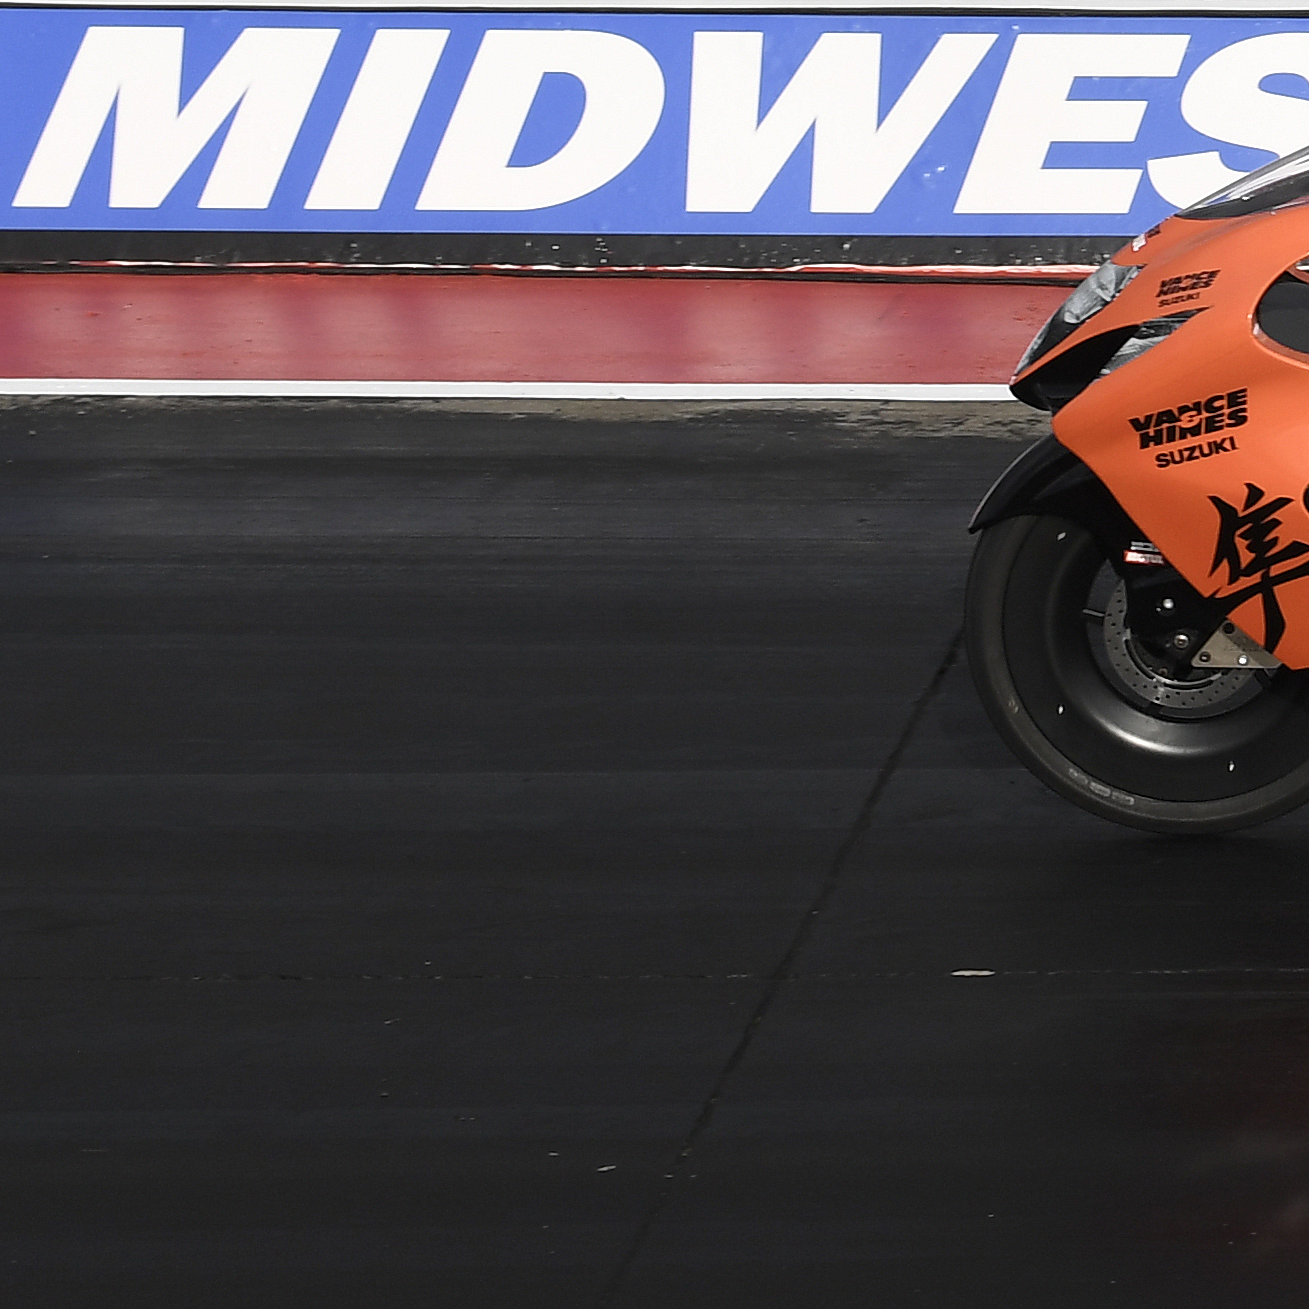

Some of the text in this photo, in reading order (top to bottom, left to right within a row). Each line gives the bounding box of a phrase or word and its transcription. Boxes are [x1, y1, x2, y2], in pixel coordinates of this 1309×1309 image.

[1128, 387, 1248, 433] VANCE
[1140, 407, 1248, 449] HINES
[1155, 436, 1239, 468] SUZUKI
